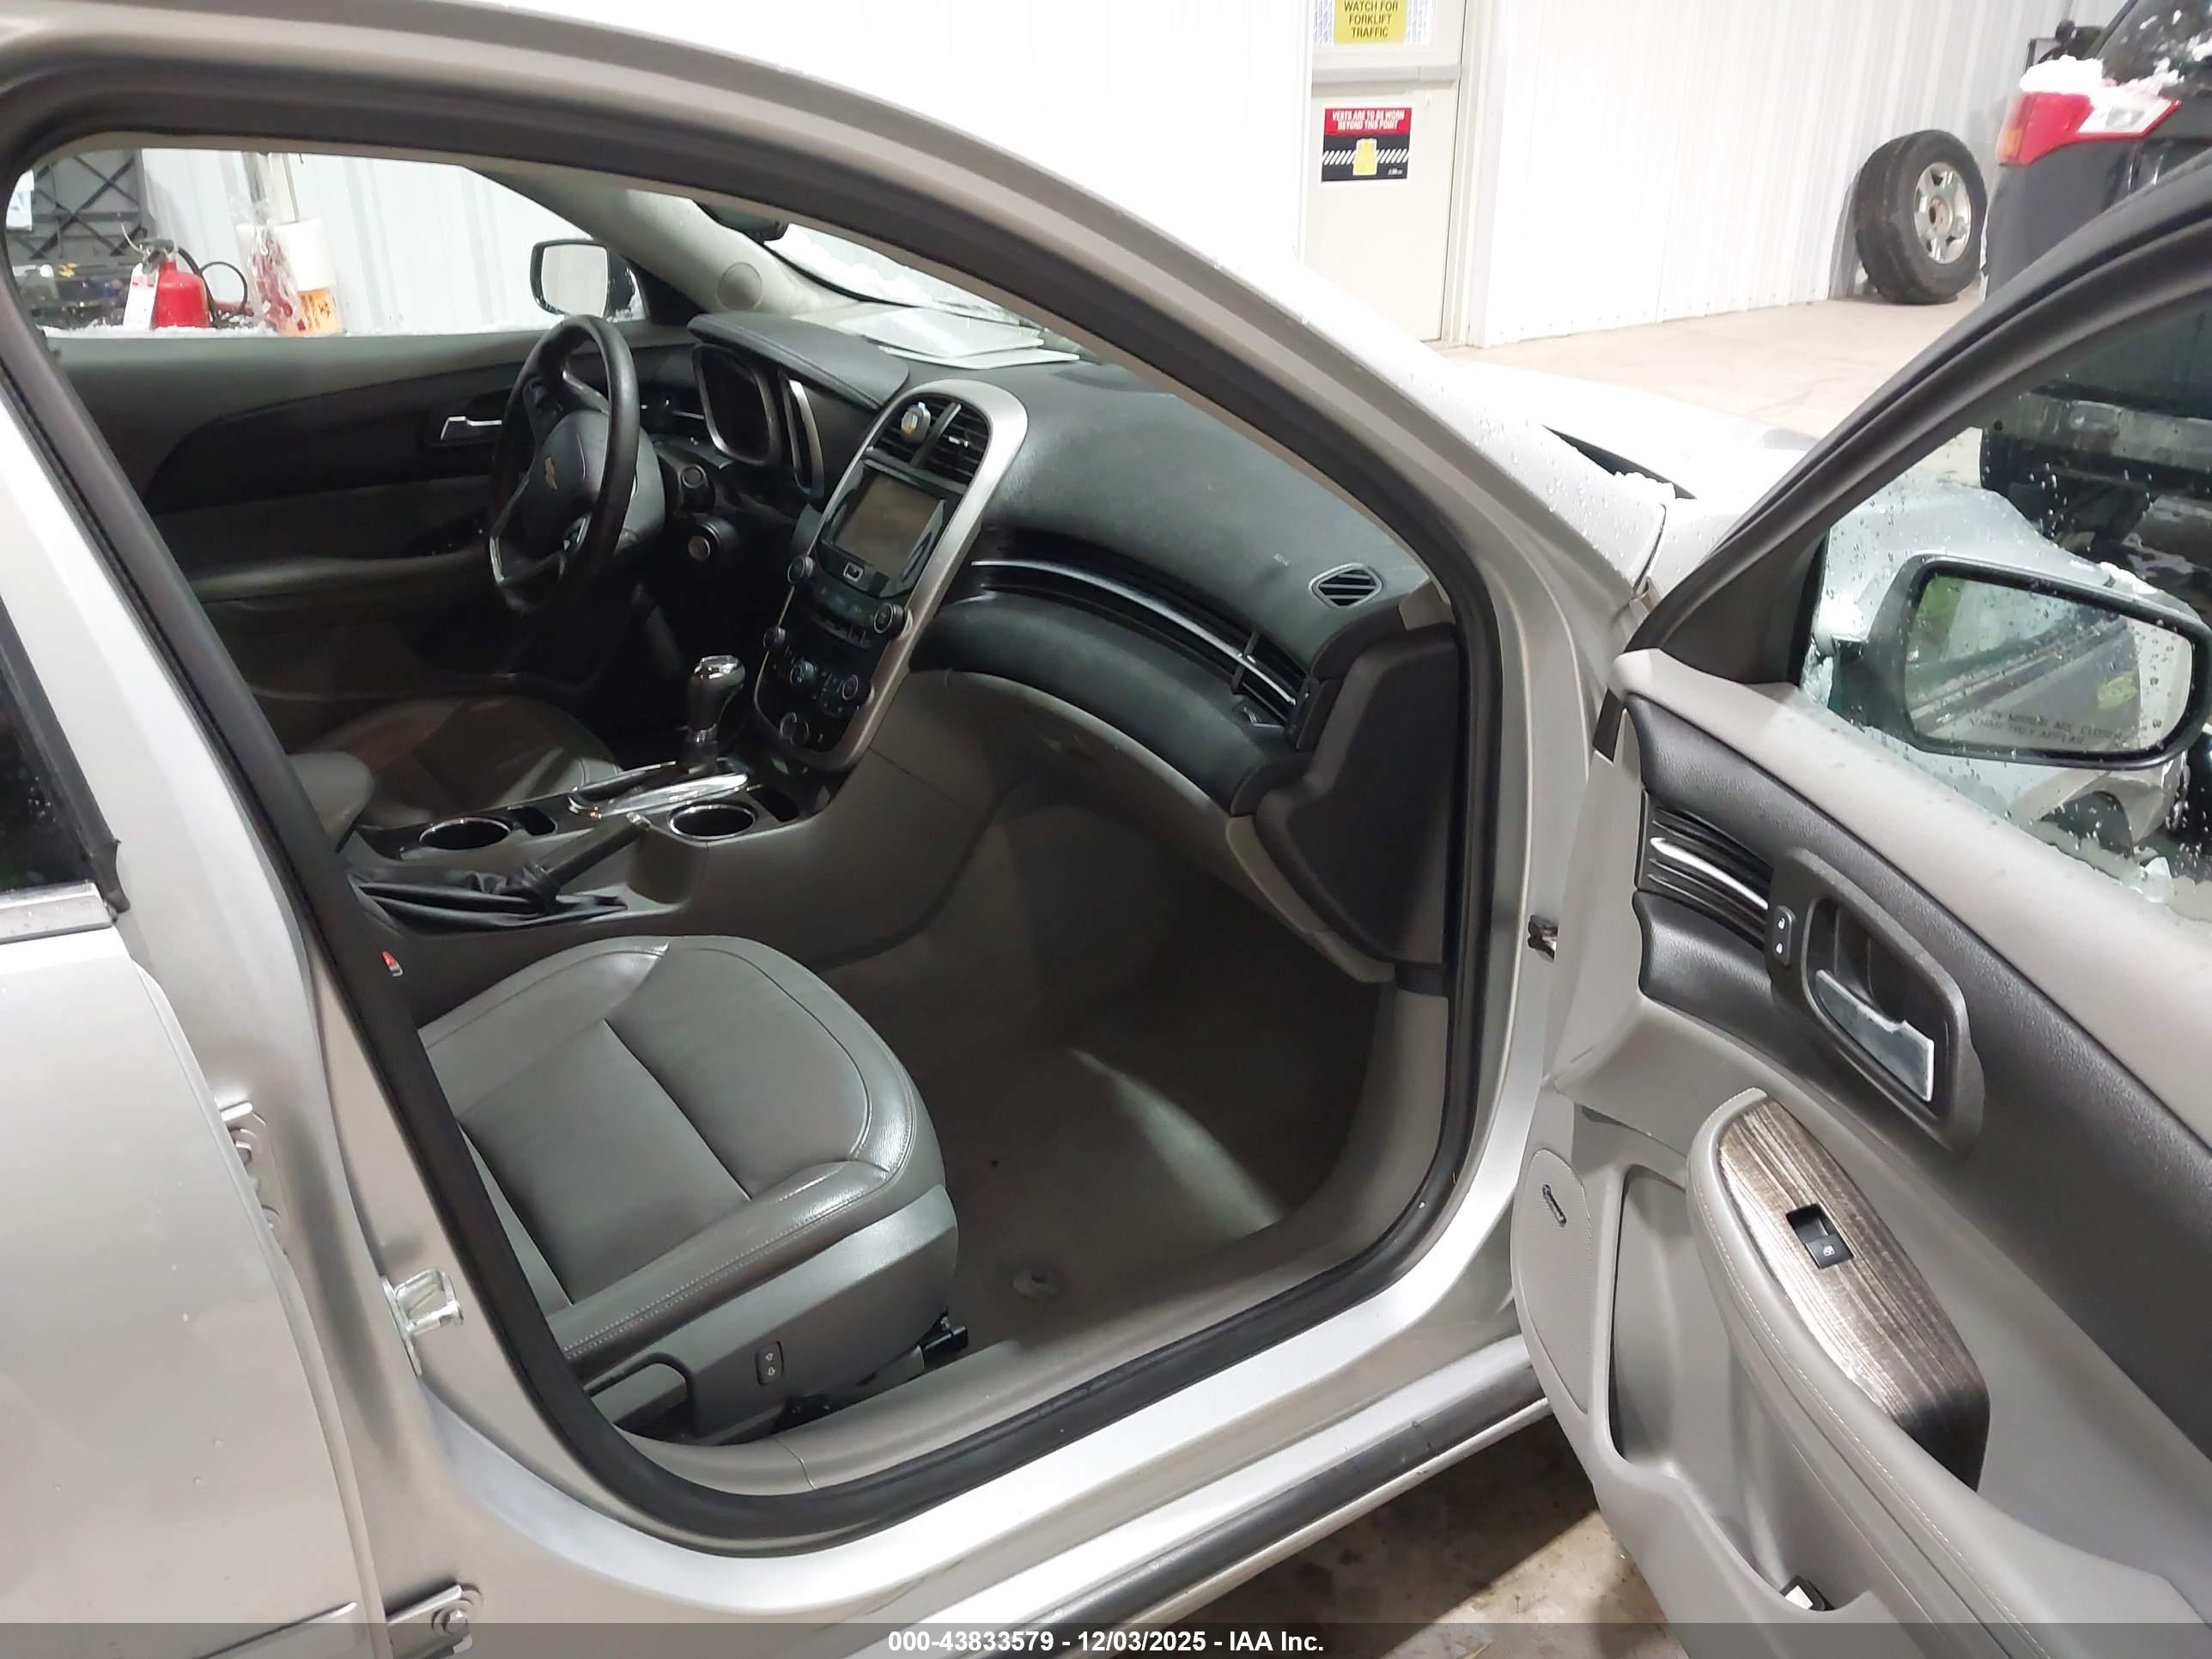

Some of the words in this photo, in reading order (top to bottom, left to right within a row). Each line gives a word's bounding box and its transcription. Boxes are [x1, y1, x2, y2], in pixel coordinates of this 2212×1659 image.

[1344, 0, 1377, 12] WATCH
[1380, 1, 1398, 12] FOR
[1349, 14, 1392, 25] FORKLIFT
[1352, 27, 1389, 38] TRAFFIC
[1379, 119, 1398, 131] POINT
